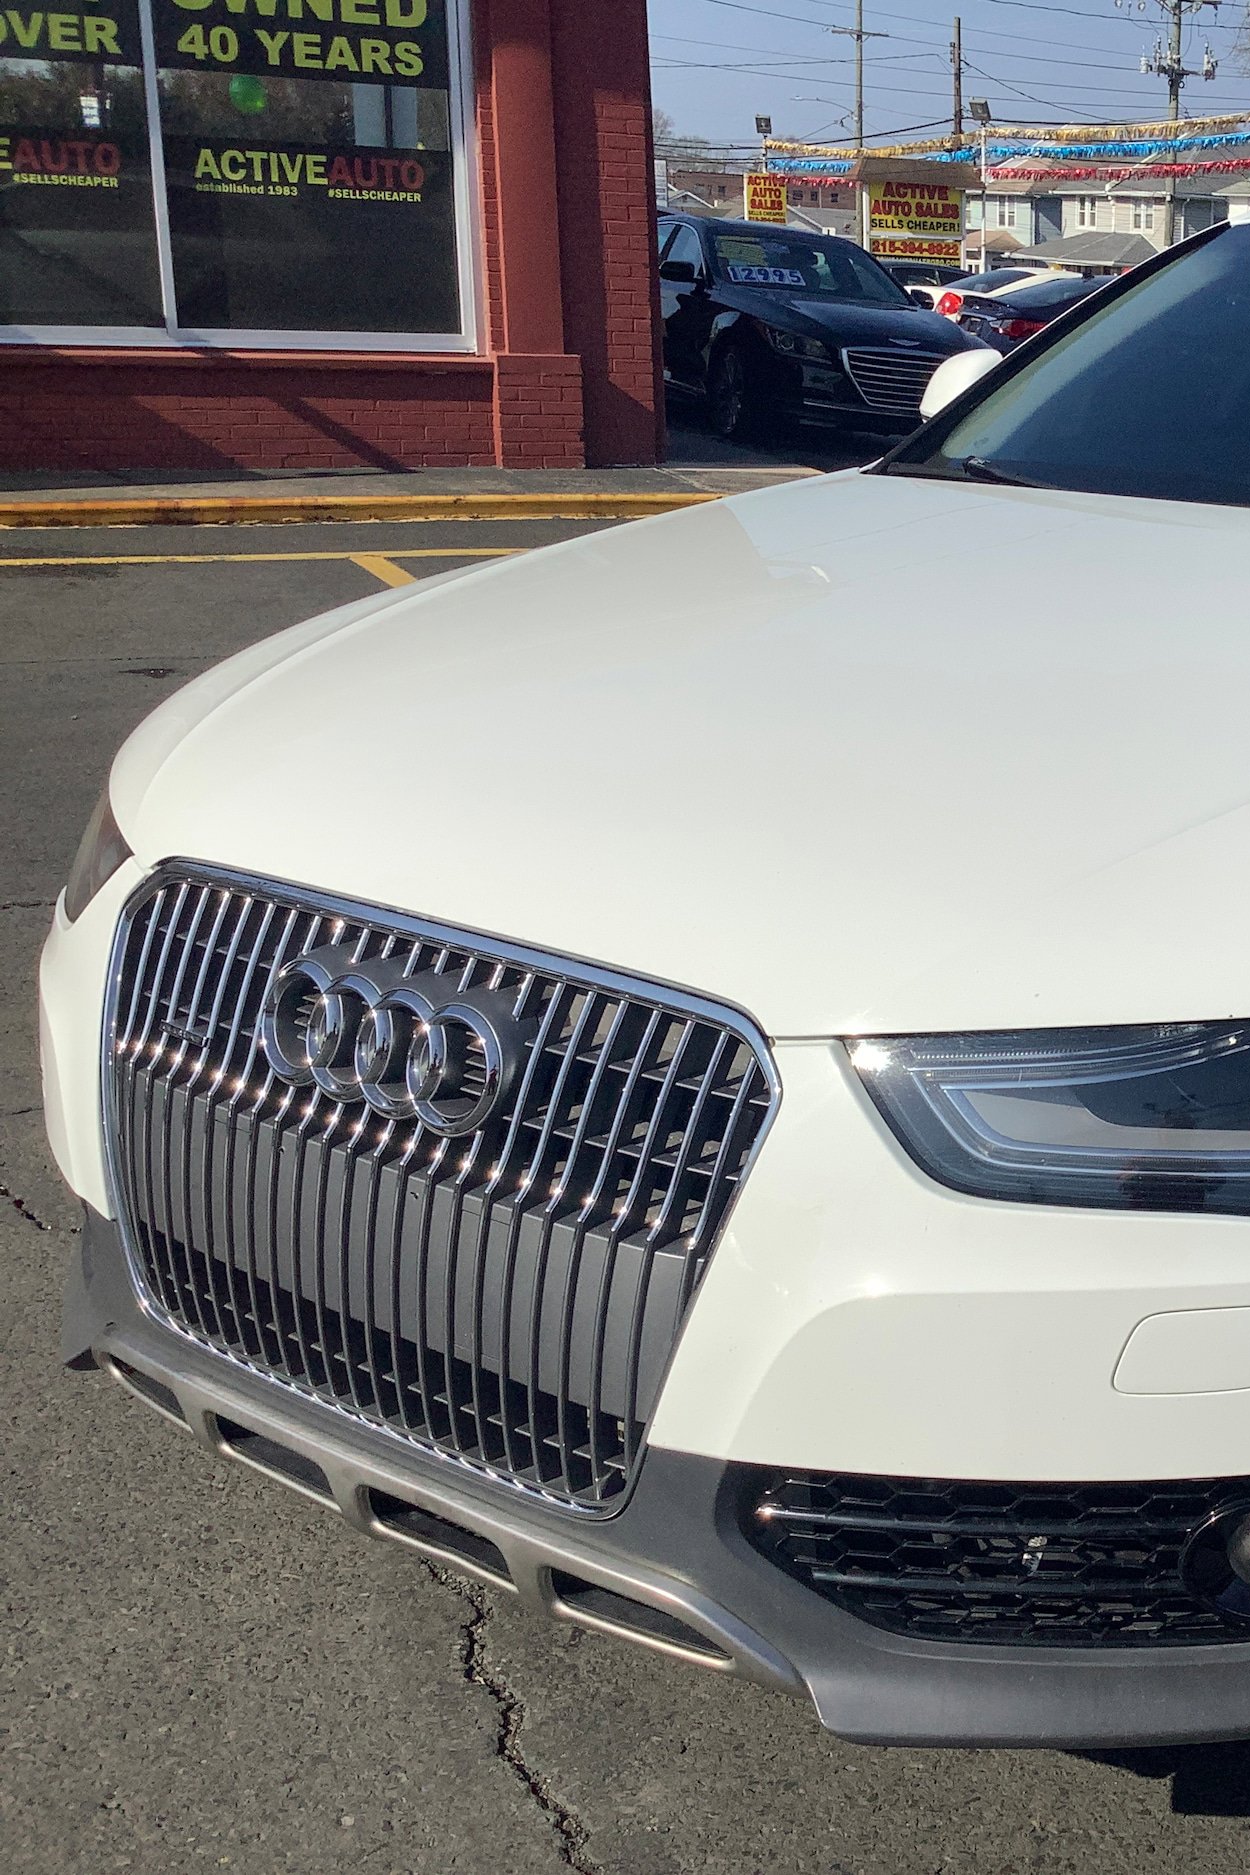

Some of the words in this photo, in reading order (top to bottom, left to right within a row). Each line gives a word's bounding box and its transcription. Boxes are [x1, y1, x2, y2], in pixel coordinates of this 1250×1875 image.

[0, 10, 122, 55] VER
[177, 24, 239, 63] 40
[254, 29, 424, 77] YEARS
[13, 172, 119, 188] #SELLSCHEAPER
[196, 182, 264, 195] established
[267, 185, 298, 197] 1983
[328, 187, 422, 203] #SELLSCHEAPER
[752, 187, 782, 199] AUTO
[883, 181, 949, 201] ACTIVE
[750, 198, 784, 211] SALES
[871, 199, 912, 218] AUTO
[915, 201, 960, 220] SALES
[871, 218, 904, 230] SELLS
[907, 219, 960, 233] CHEAPER!
[730, 267, 801, 284] 12995
